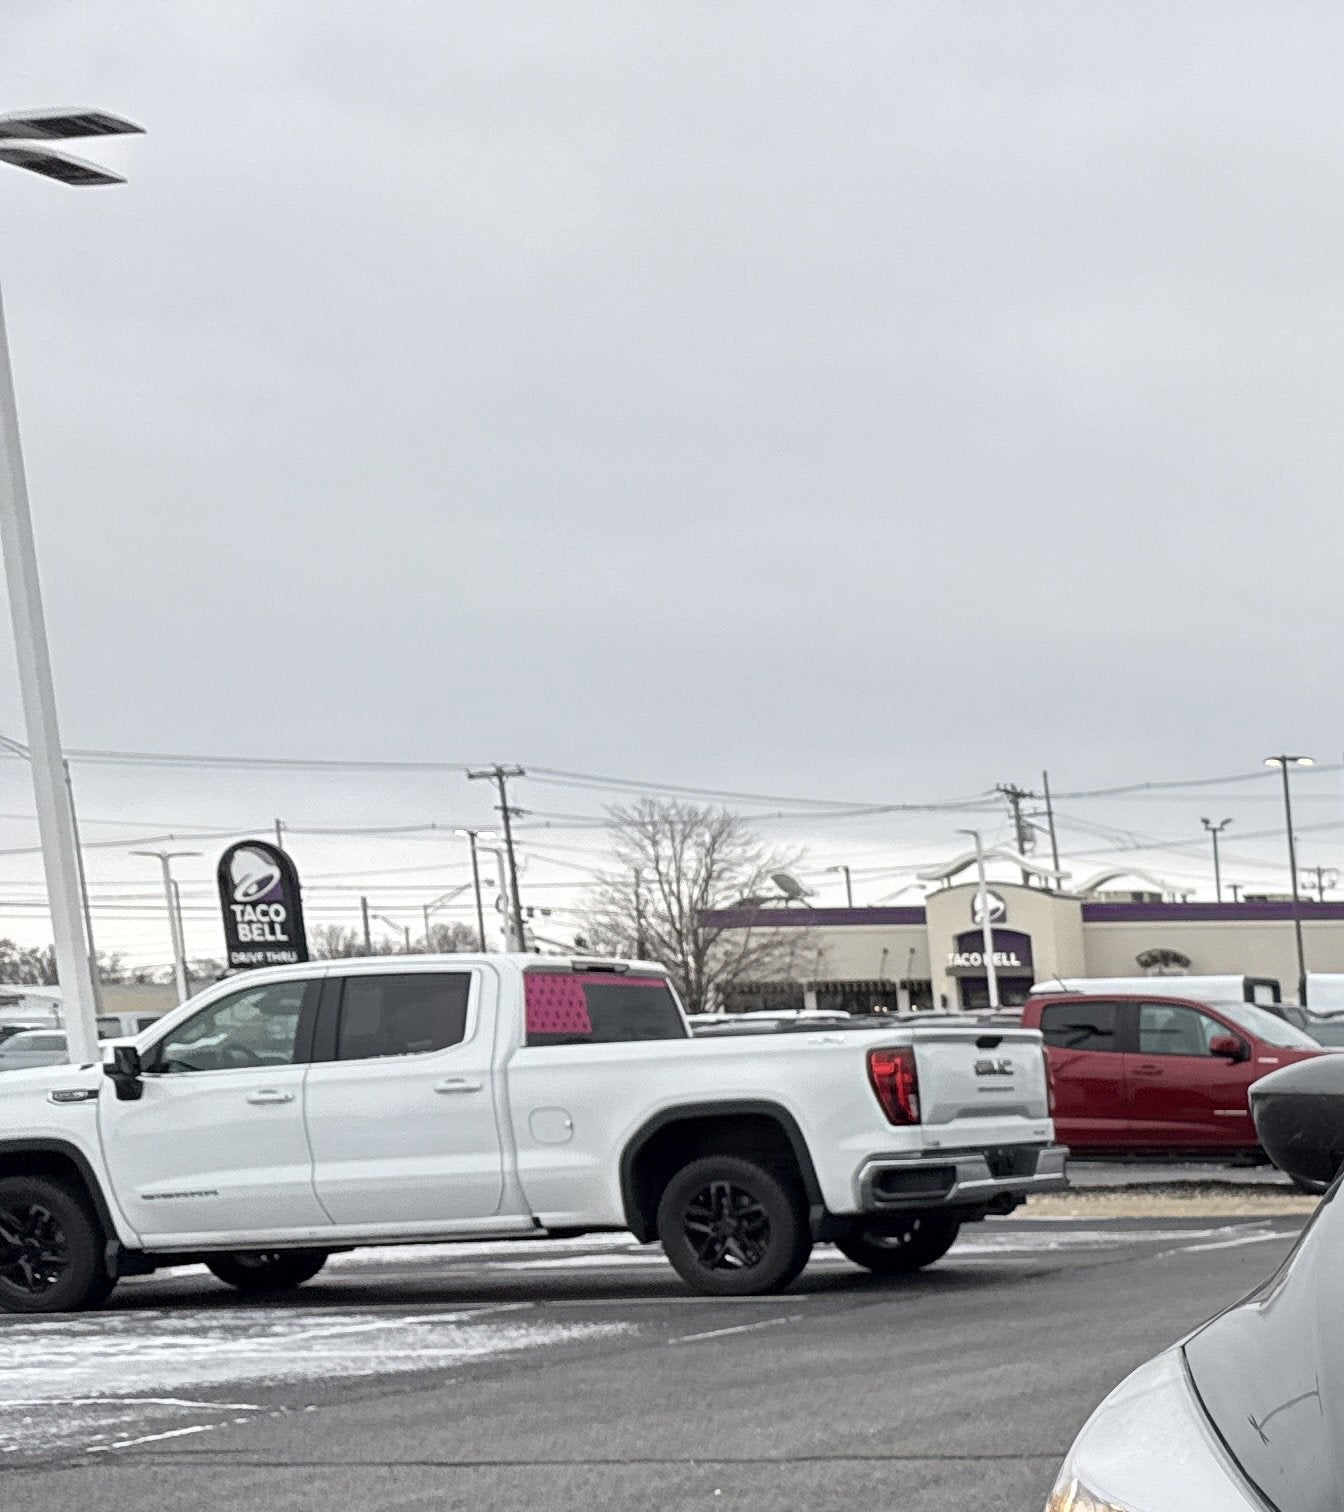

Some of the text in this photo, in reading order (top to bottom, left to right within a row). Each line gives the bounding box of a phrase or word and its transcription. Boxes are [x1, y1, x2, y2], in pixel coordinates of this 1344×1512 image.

[230, 903, 287, 922] TACO
[238, 922, 289, 942] BELL
[948, 951, 982, 967] TACO
